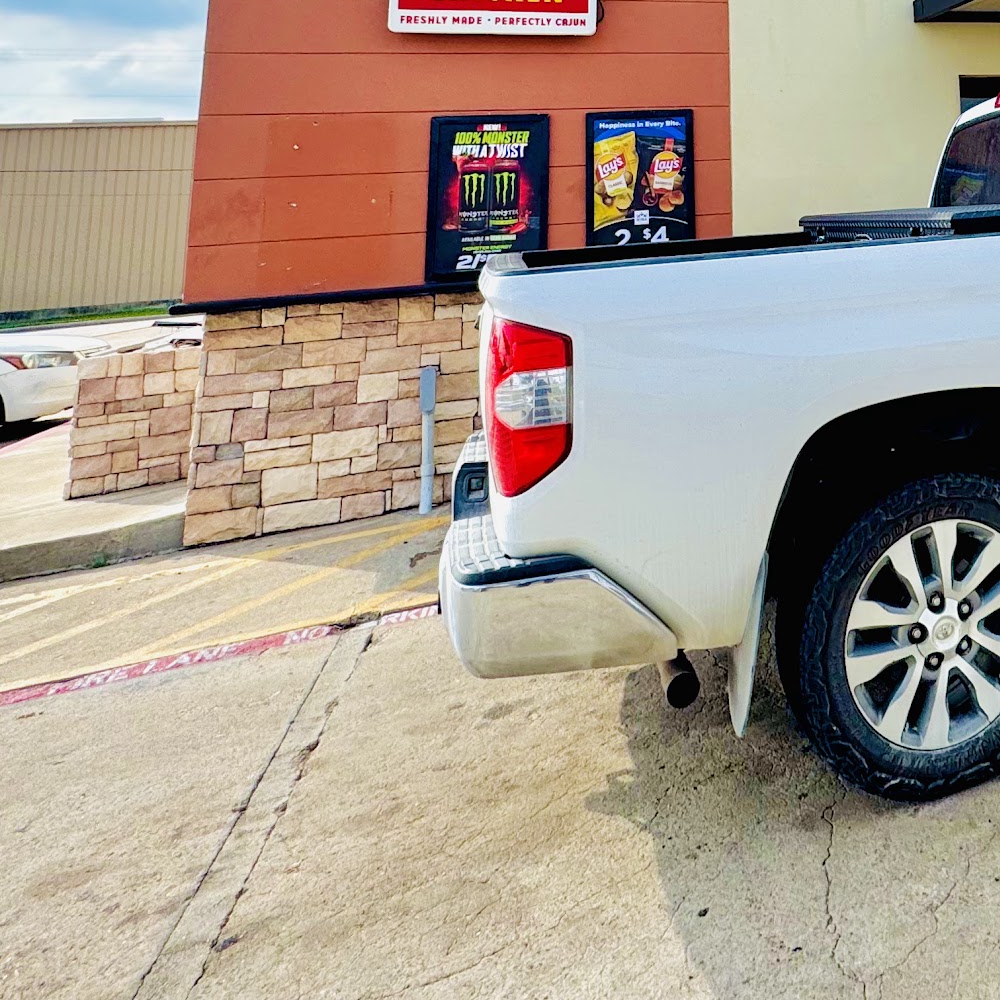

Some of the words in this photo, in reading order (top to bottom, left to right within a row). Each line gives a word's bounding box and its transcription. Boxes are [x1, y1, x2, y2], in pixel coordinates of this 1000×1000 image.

[400, 15, 447, 25] FRESHLY
[452, 16, 482, 25] MADE
[494, 17, 551, 26] PERFECTLY
[555, 18, 586, 27] CAJUN
[599, 121, 635, 130] Happiness
[645, 121, 664, 129] Every
[454, 131, 482, 145] 100%
[482, 131, 530, 145] MONSTER
[452, 144, 480, 157] WITH
[488, 144, 528, 158] TWIST
[597, 156, 625, 178] Lay's
[654, 157, 680, 172] Lay's
[284, 624, 333, 646] NO
